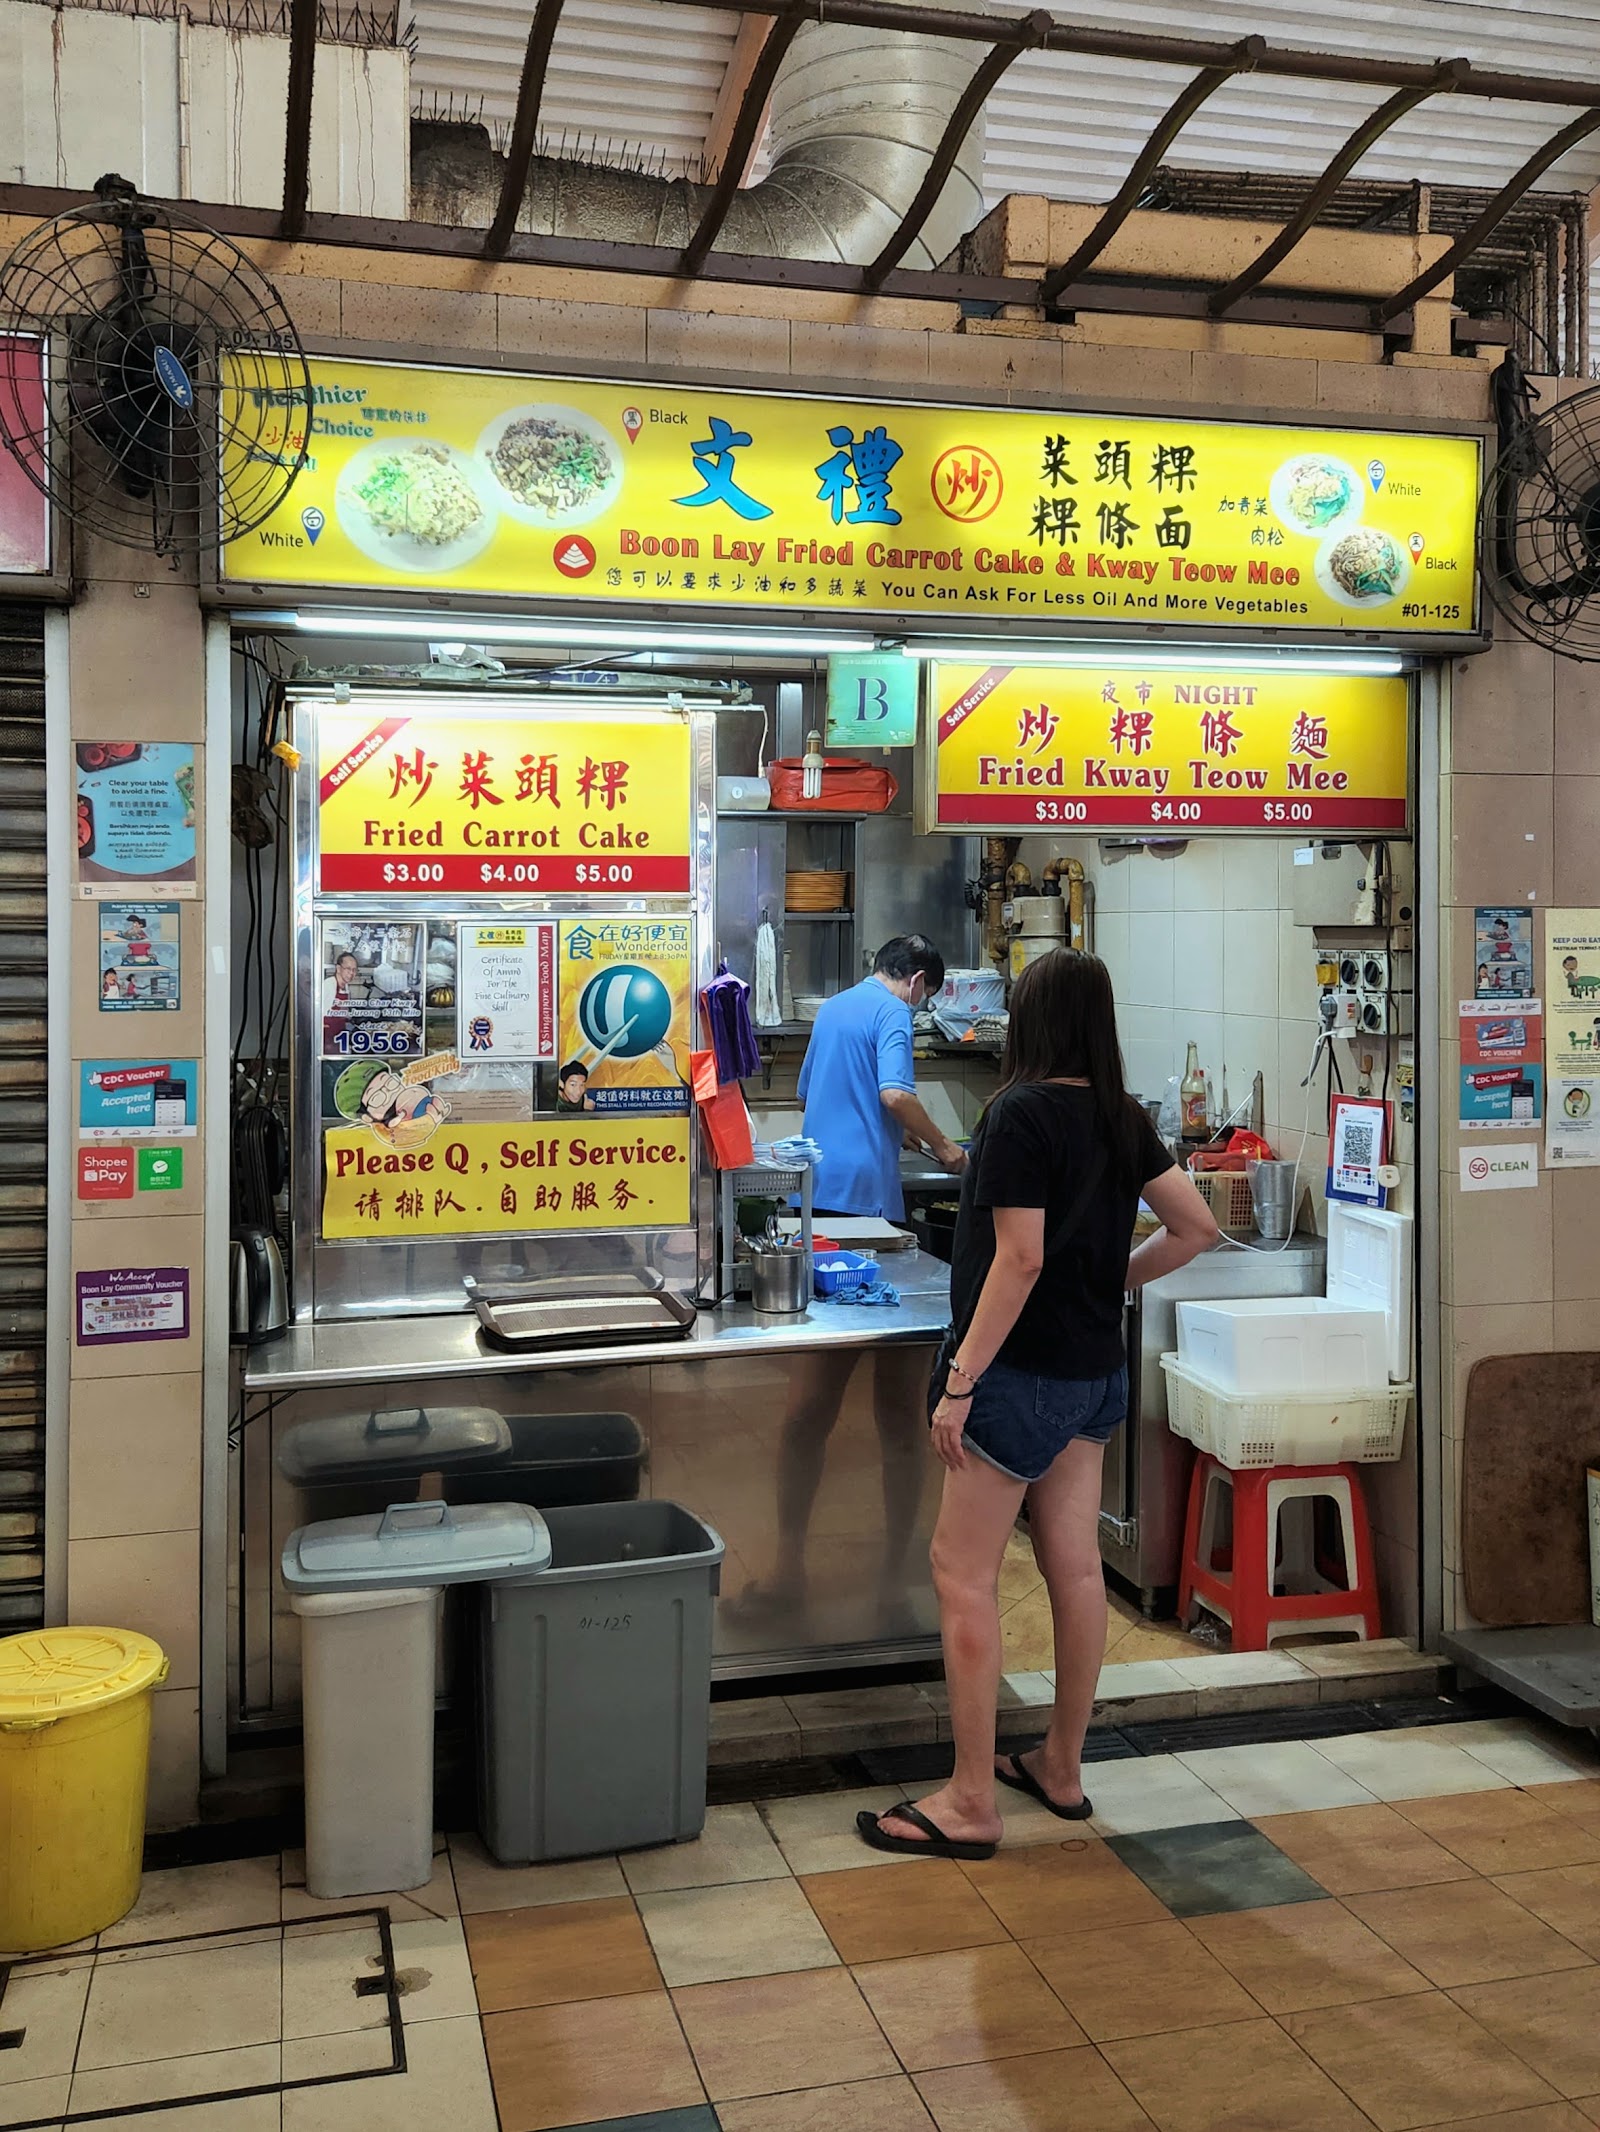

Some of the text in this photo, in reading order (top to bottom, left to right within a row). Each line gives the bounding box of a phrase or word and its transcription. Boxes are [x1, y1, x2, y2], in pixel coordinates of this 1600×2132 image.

[650, 409, 688, 425] Black
[311, 417, 374, 438] Choice
[670, 416, 904, 526] 文禮
[1040, 433, 1198, 494] 菜頭粿
[945, 453, 994, 517] 炒
[1388, 482, 1421, 496] White
[1217, 495, 1268, 517] 加青菜
[1027, 496, 1193, 550] 粿條面
[260, 530, 304, 548] White
[1250, 526, 1285, 546] 肉松
[620, 529, 1300, 586] Boon Lay Fried Carrot Cake & Kway Teow Mee
[1425, 556, 1458, 571] Black
[881, 582, 1308, 615] You Can Ask For Less Oil And More Vegetables
[1402, 603, 1460, 619] #01-125
[852, 677, 889, 722] B
[1100, 679, 1154, 706] 夜市
[1174, 684, 1258, 706] NIGHT
[944, 676, 996, 729] Self Service
[327, 732, 385, 787] Self Service
[388, 747, 630, 811] 炒菜頭粿
[979, 757, 1349, 794] Fried Kway Teow Mee
[1035, 801, 1313, 822] $3.00 $4.00 $5.00
[364, 820, 650, 849] Fried Carrot Cake
[383, 862, 633, 883] $3.00 $4.00 $5.00
[564, 925, 688, 960] 食在好便宜
[615, 941, 688, 951] Wonderfood
[481, 956, 523, 965] Certificate
[483, 968, 494, 977] Of
[487, 980, 517, 988] For The
[540, 931, 552, 1039] Singapore Food Map
[332, 999, 417, 1009] Famous Char Kway
[475, 992, 530, 1001] Fine Culinary
[326, 1009, 421, 1018] from Jurong 13th Mile
[358, 1022, 387, 1030] since
[334, 1031, 409, 1054] 1956
[432, 1059, 461, 1076] King
[103, 1069, 166, 1085] CDC Voucher
[1476, 1072, 1519, 1084] CDC Voucher
[101, 1092, 151, 1107] Accepted
[1474, 1090, 1510, 1103] Accepted
[126, 1104, 151, 1114] here
[1492, 1101, 1510, 1110] here
[84, 1156, 127, 1167] Shopee
[335, 1148, 435, 1177] Please
[445, 1142, 470, 1175] Q
[500, 1139, 560, 1170] Self
[568, 1137, 687, 1167] Service.
[1472, 1160, 1529, 1173] SG CLEAN
[99, 1170, 127, 1184] Pay
[109, 1271, 156, 1282] We Accept
[81, 1281, 184, 1294] Boon Lay Community Voucher
[580, 1615, 633, 1631] 01-125
